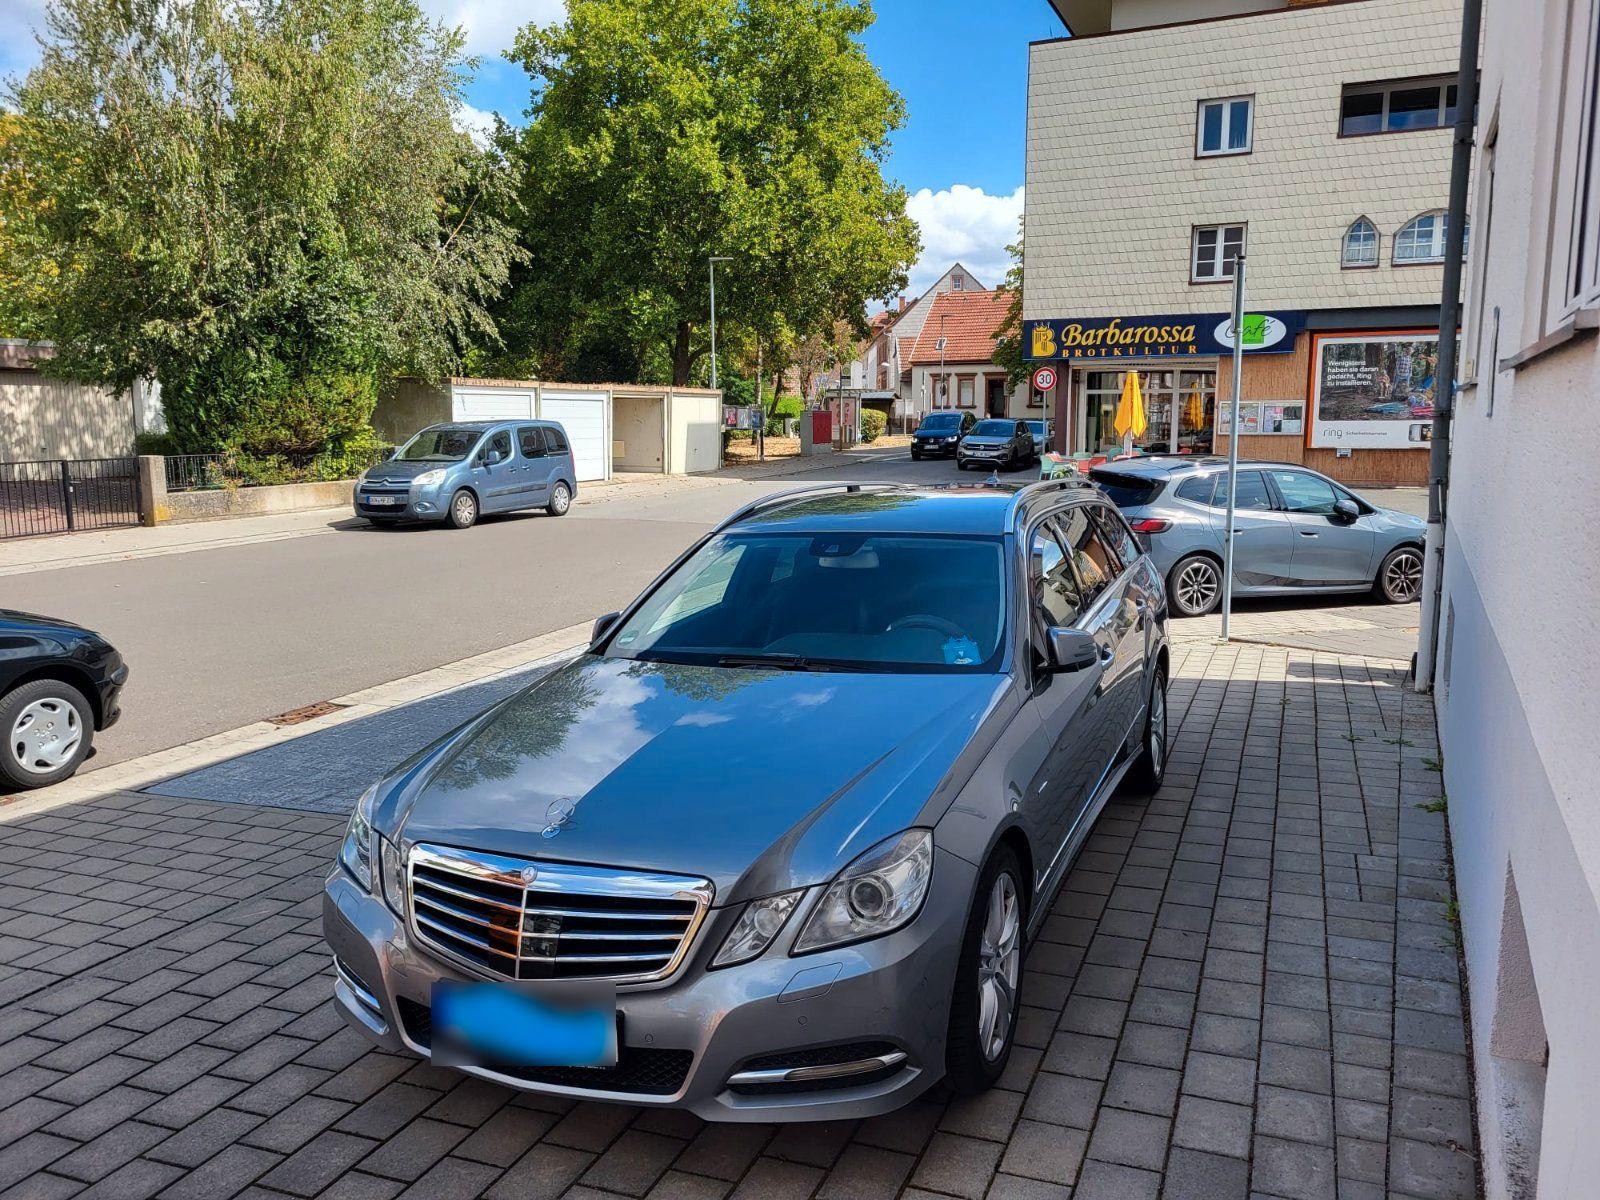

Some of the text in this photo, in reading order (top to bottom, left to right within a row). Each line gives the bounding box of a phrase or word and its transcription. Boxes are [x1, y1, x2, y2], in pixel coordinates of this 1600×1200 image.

[1061, 318, 1196, 346] Barbarossa
[1062, 344, 1197, 358] BROTKULTUR
[1038, 373, 1052, 385] 30
[1323, 428, 1343, 439] ring
